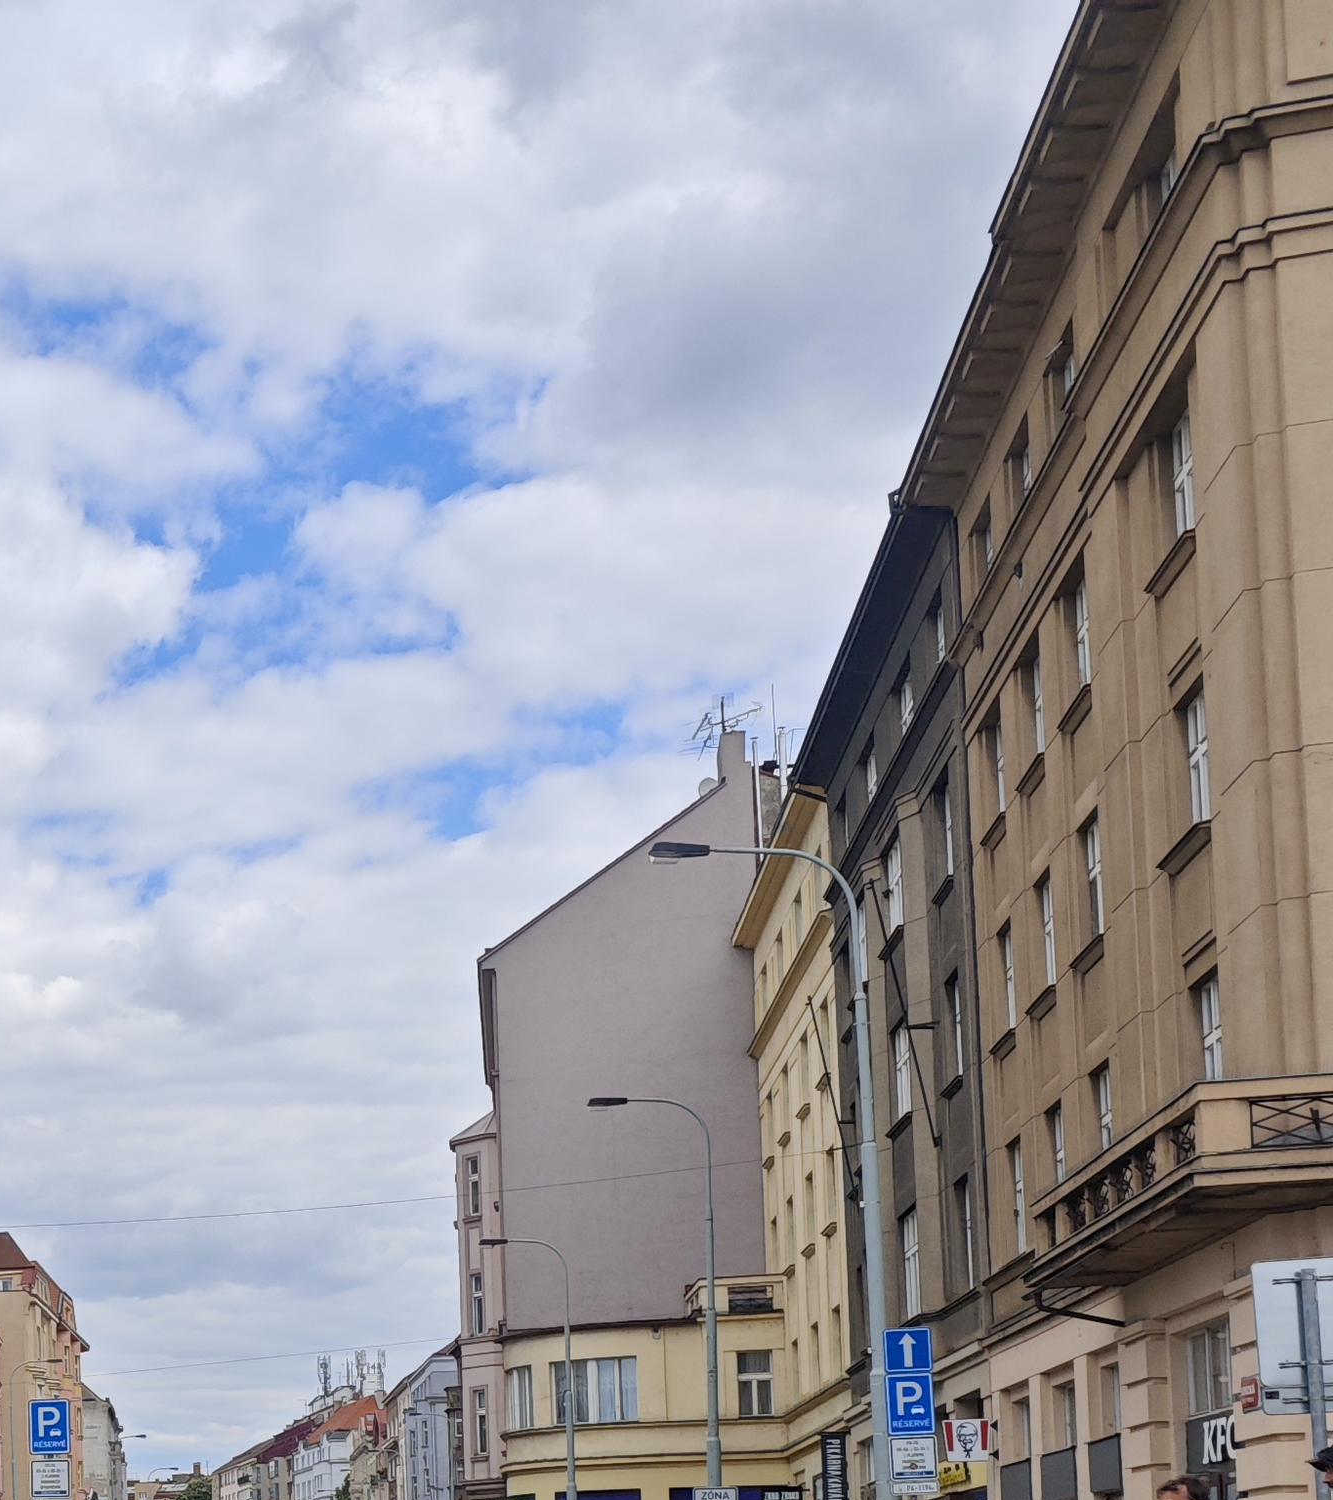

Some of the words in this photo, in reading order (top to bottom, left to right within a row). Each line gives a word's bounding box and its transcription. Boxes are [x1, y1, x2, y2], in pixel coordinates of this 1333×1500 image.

[895, 1381, 922, 1416] P
[37, 1406, 61, 1438] P
[892, 1419, 931, 1429] RÉSERVÉ
[33, 1440, 66, 1449] RÉSERVÉ
[701, 1491, 730, 1500] ZÓNA
